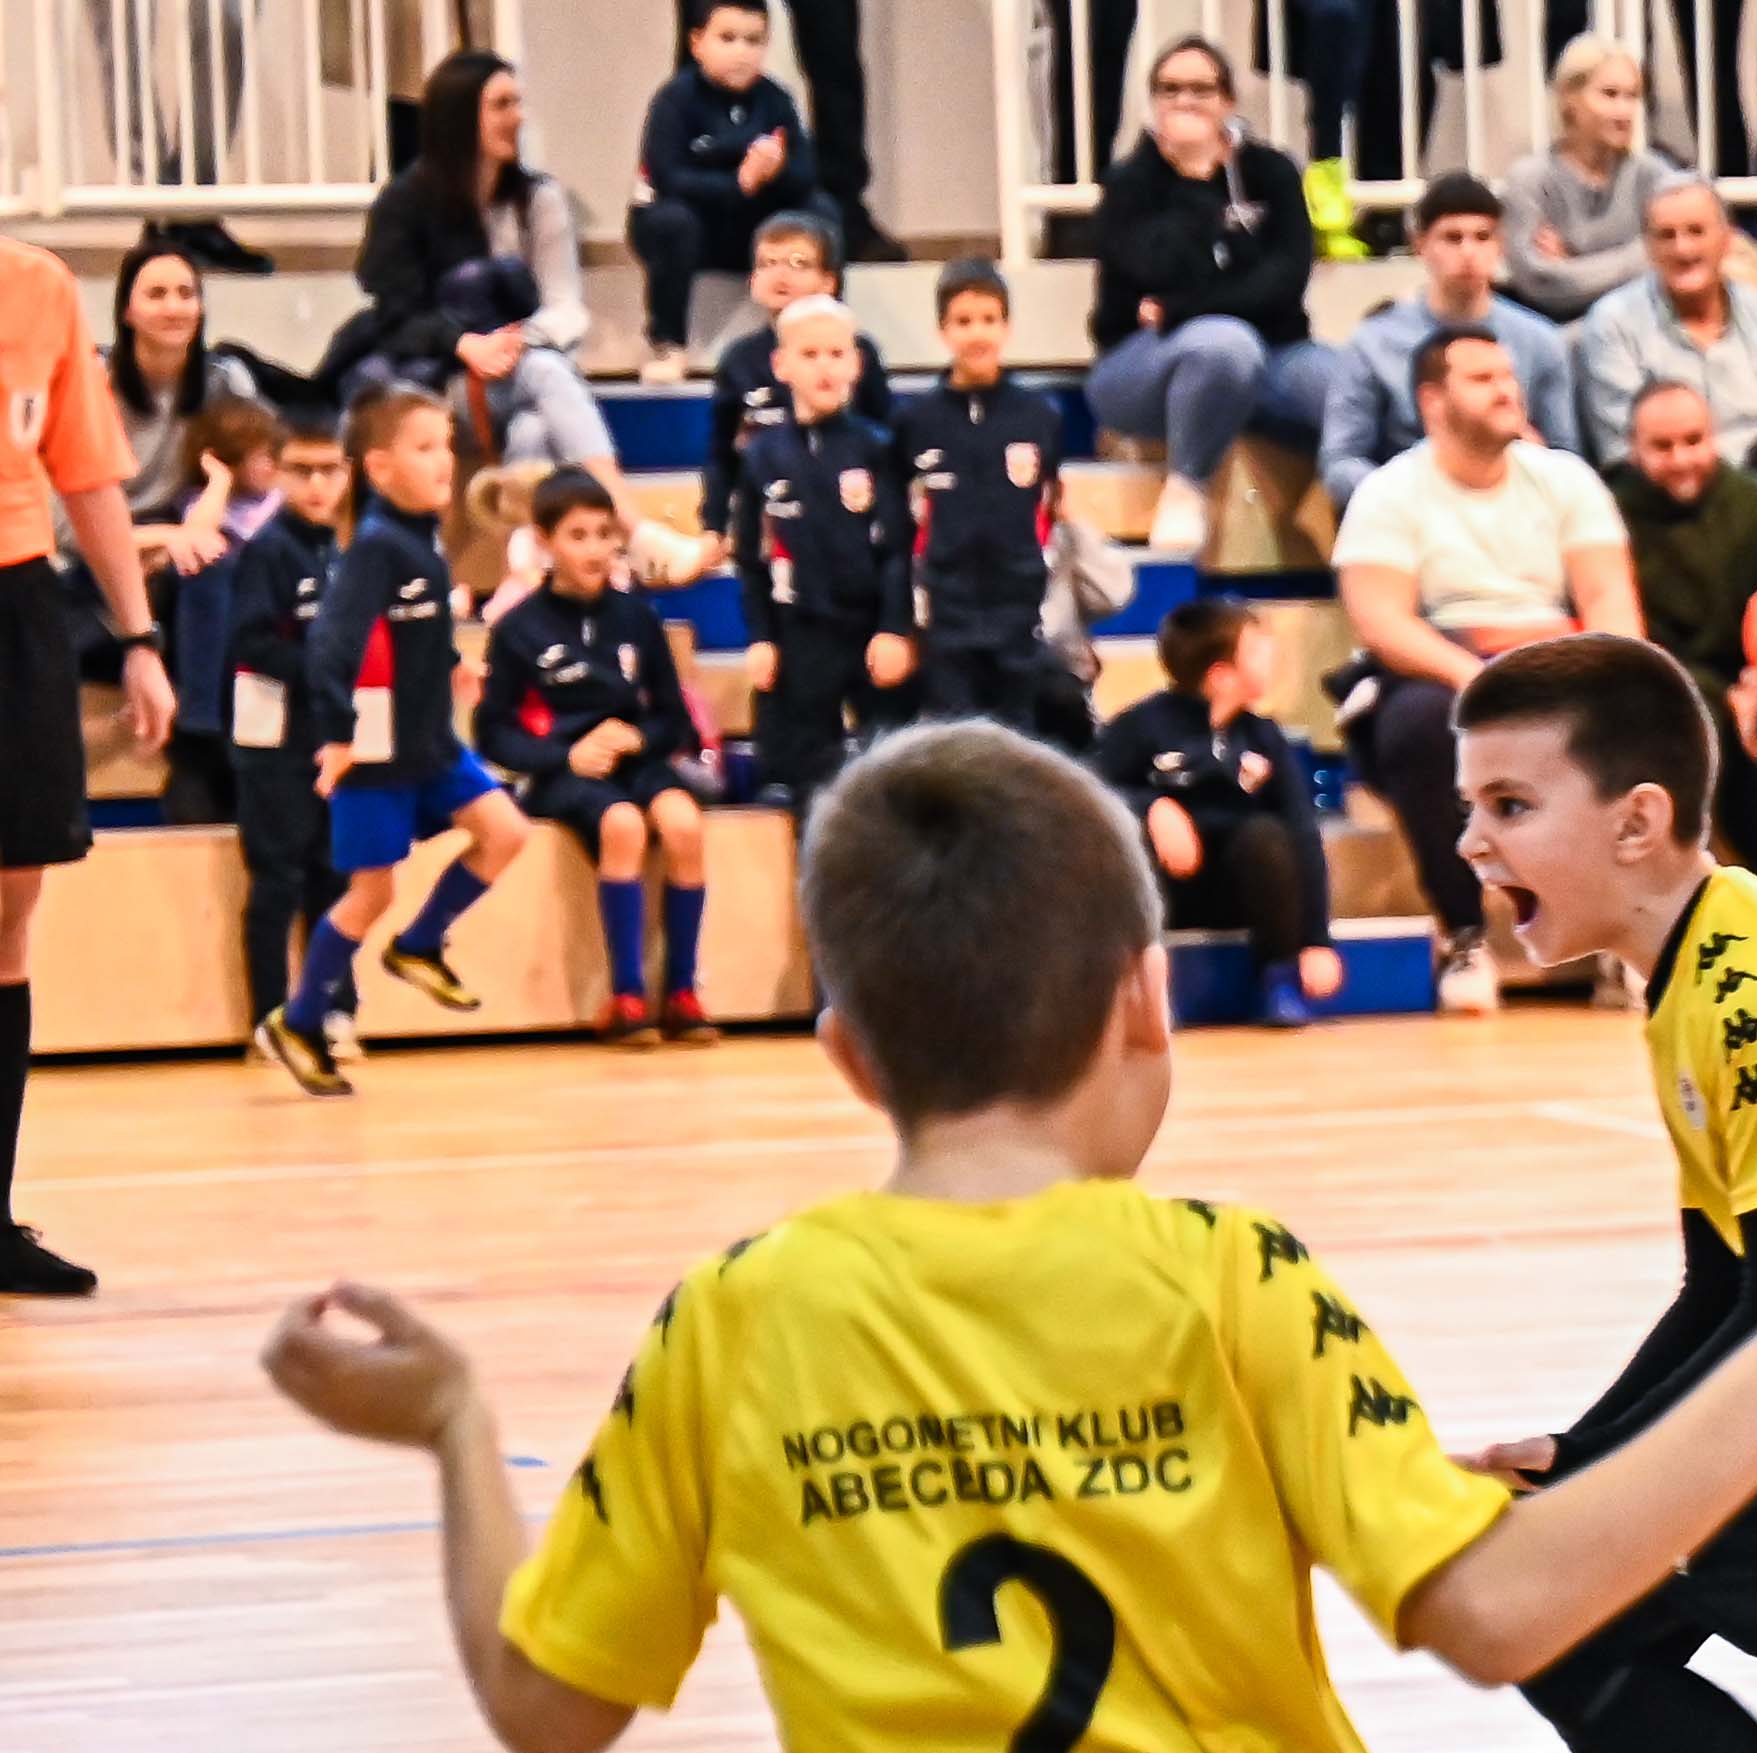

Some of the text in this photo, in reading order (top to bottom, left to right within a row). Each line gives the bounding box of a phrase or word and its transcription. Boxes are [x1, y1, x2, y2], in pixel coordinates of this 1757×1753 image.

[1057, 1399, 1186, 1448] KLUB
[801, 1449, 1192, 1526] ABECEDA ZDC
